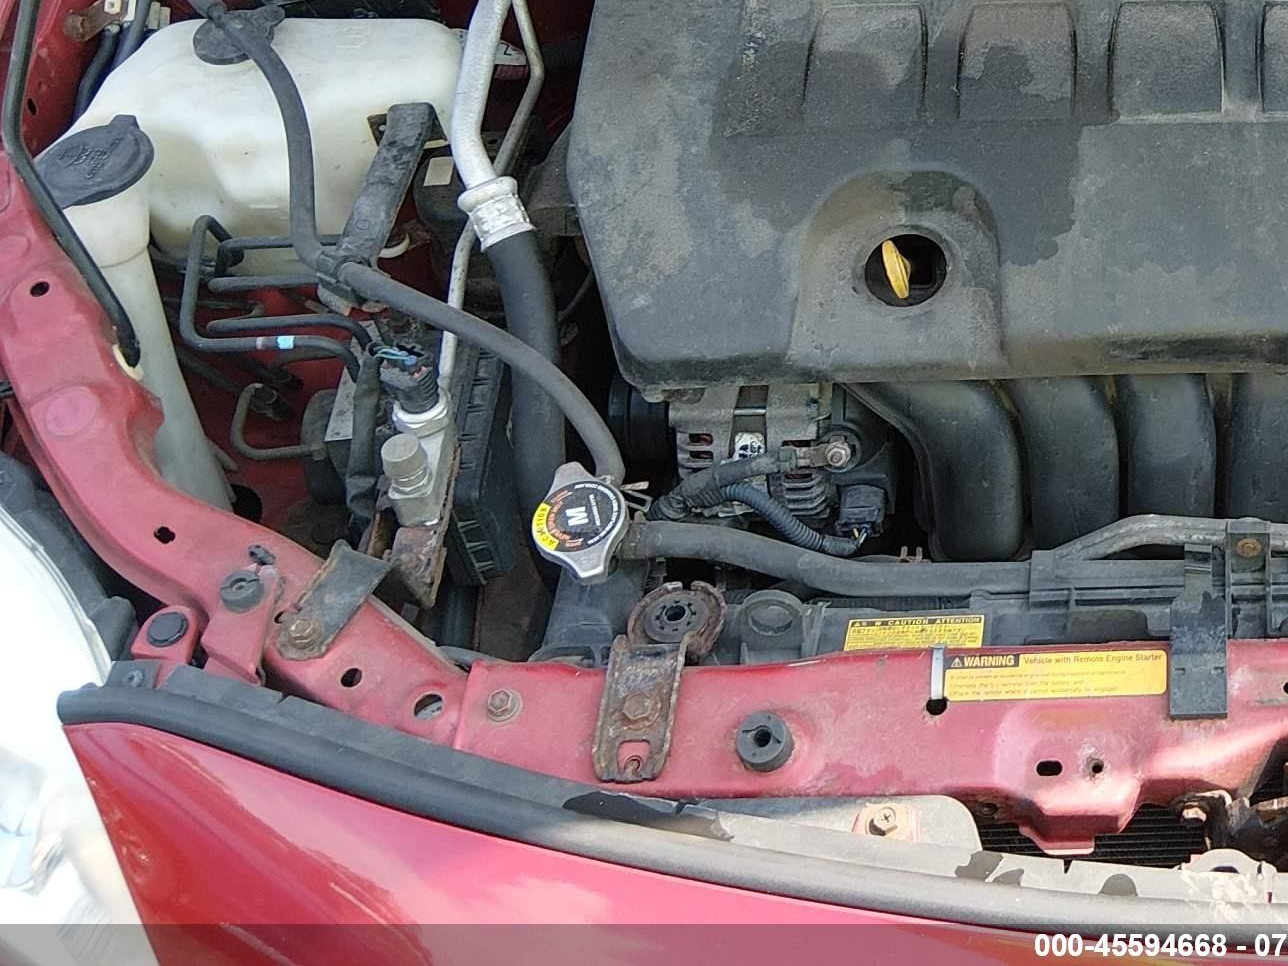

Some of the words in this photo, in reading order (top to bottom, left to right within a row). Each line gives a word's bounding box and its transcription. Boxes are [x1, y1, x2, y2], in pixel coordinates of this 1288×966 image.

[963, 655, 1015, 667] WARNING
[1024, 656, 1053, 665] Vehicle
[1055, 656, 1071, 664] with
[1073, 655, 1104, 663] Remote
[1106, 654, 1133, 664] Engine
[1135, 653, 1162, 661] Starter
